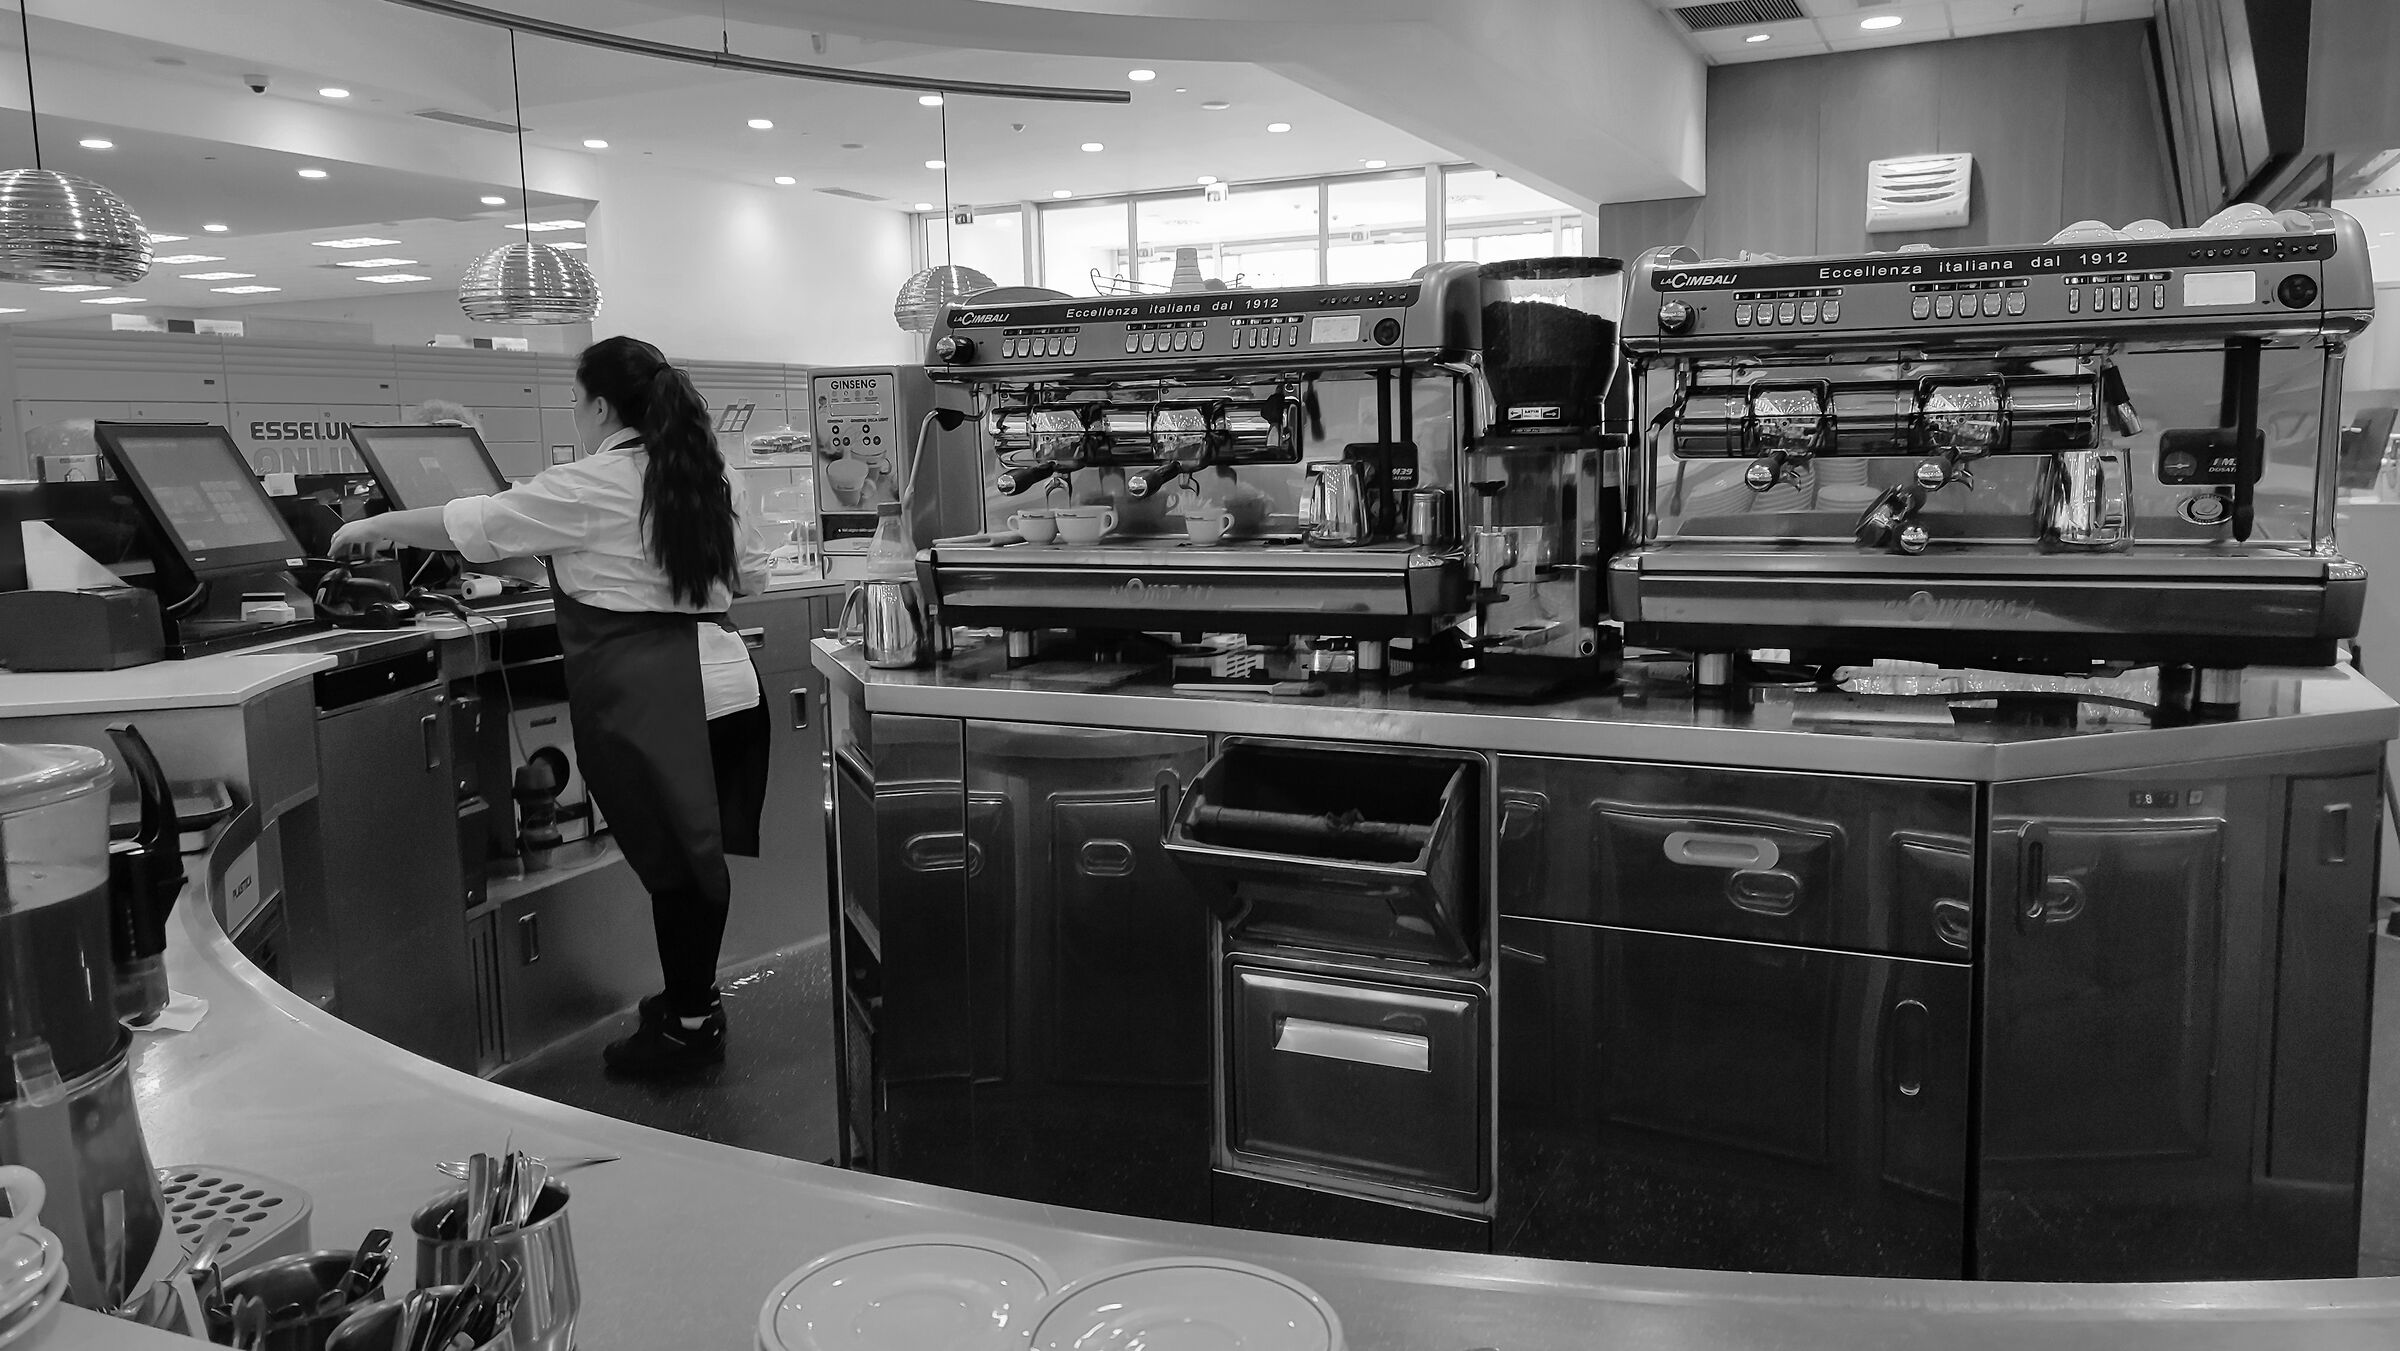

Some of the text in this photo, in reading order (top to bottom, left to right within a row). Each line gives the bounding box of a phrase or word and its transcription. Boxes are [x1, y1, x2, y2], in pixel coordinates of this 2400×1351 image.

[1819, 251, 2129, 279] Eccellenza italiana dal 1912
[1066, 298, 1279, 318] Eccellenza italiana dal 1912
[830, 379, 877, 390] GINSENG
[250, 421, 352, 441] ESSELUN
[253, 447, 368, 474] ONLIN
